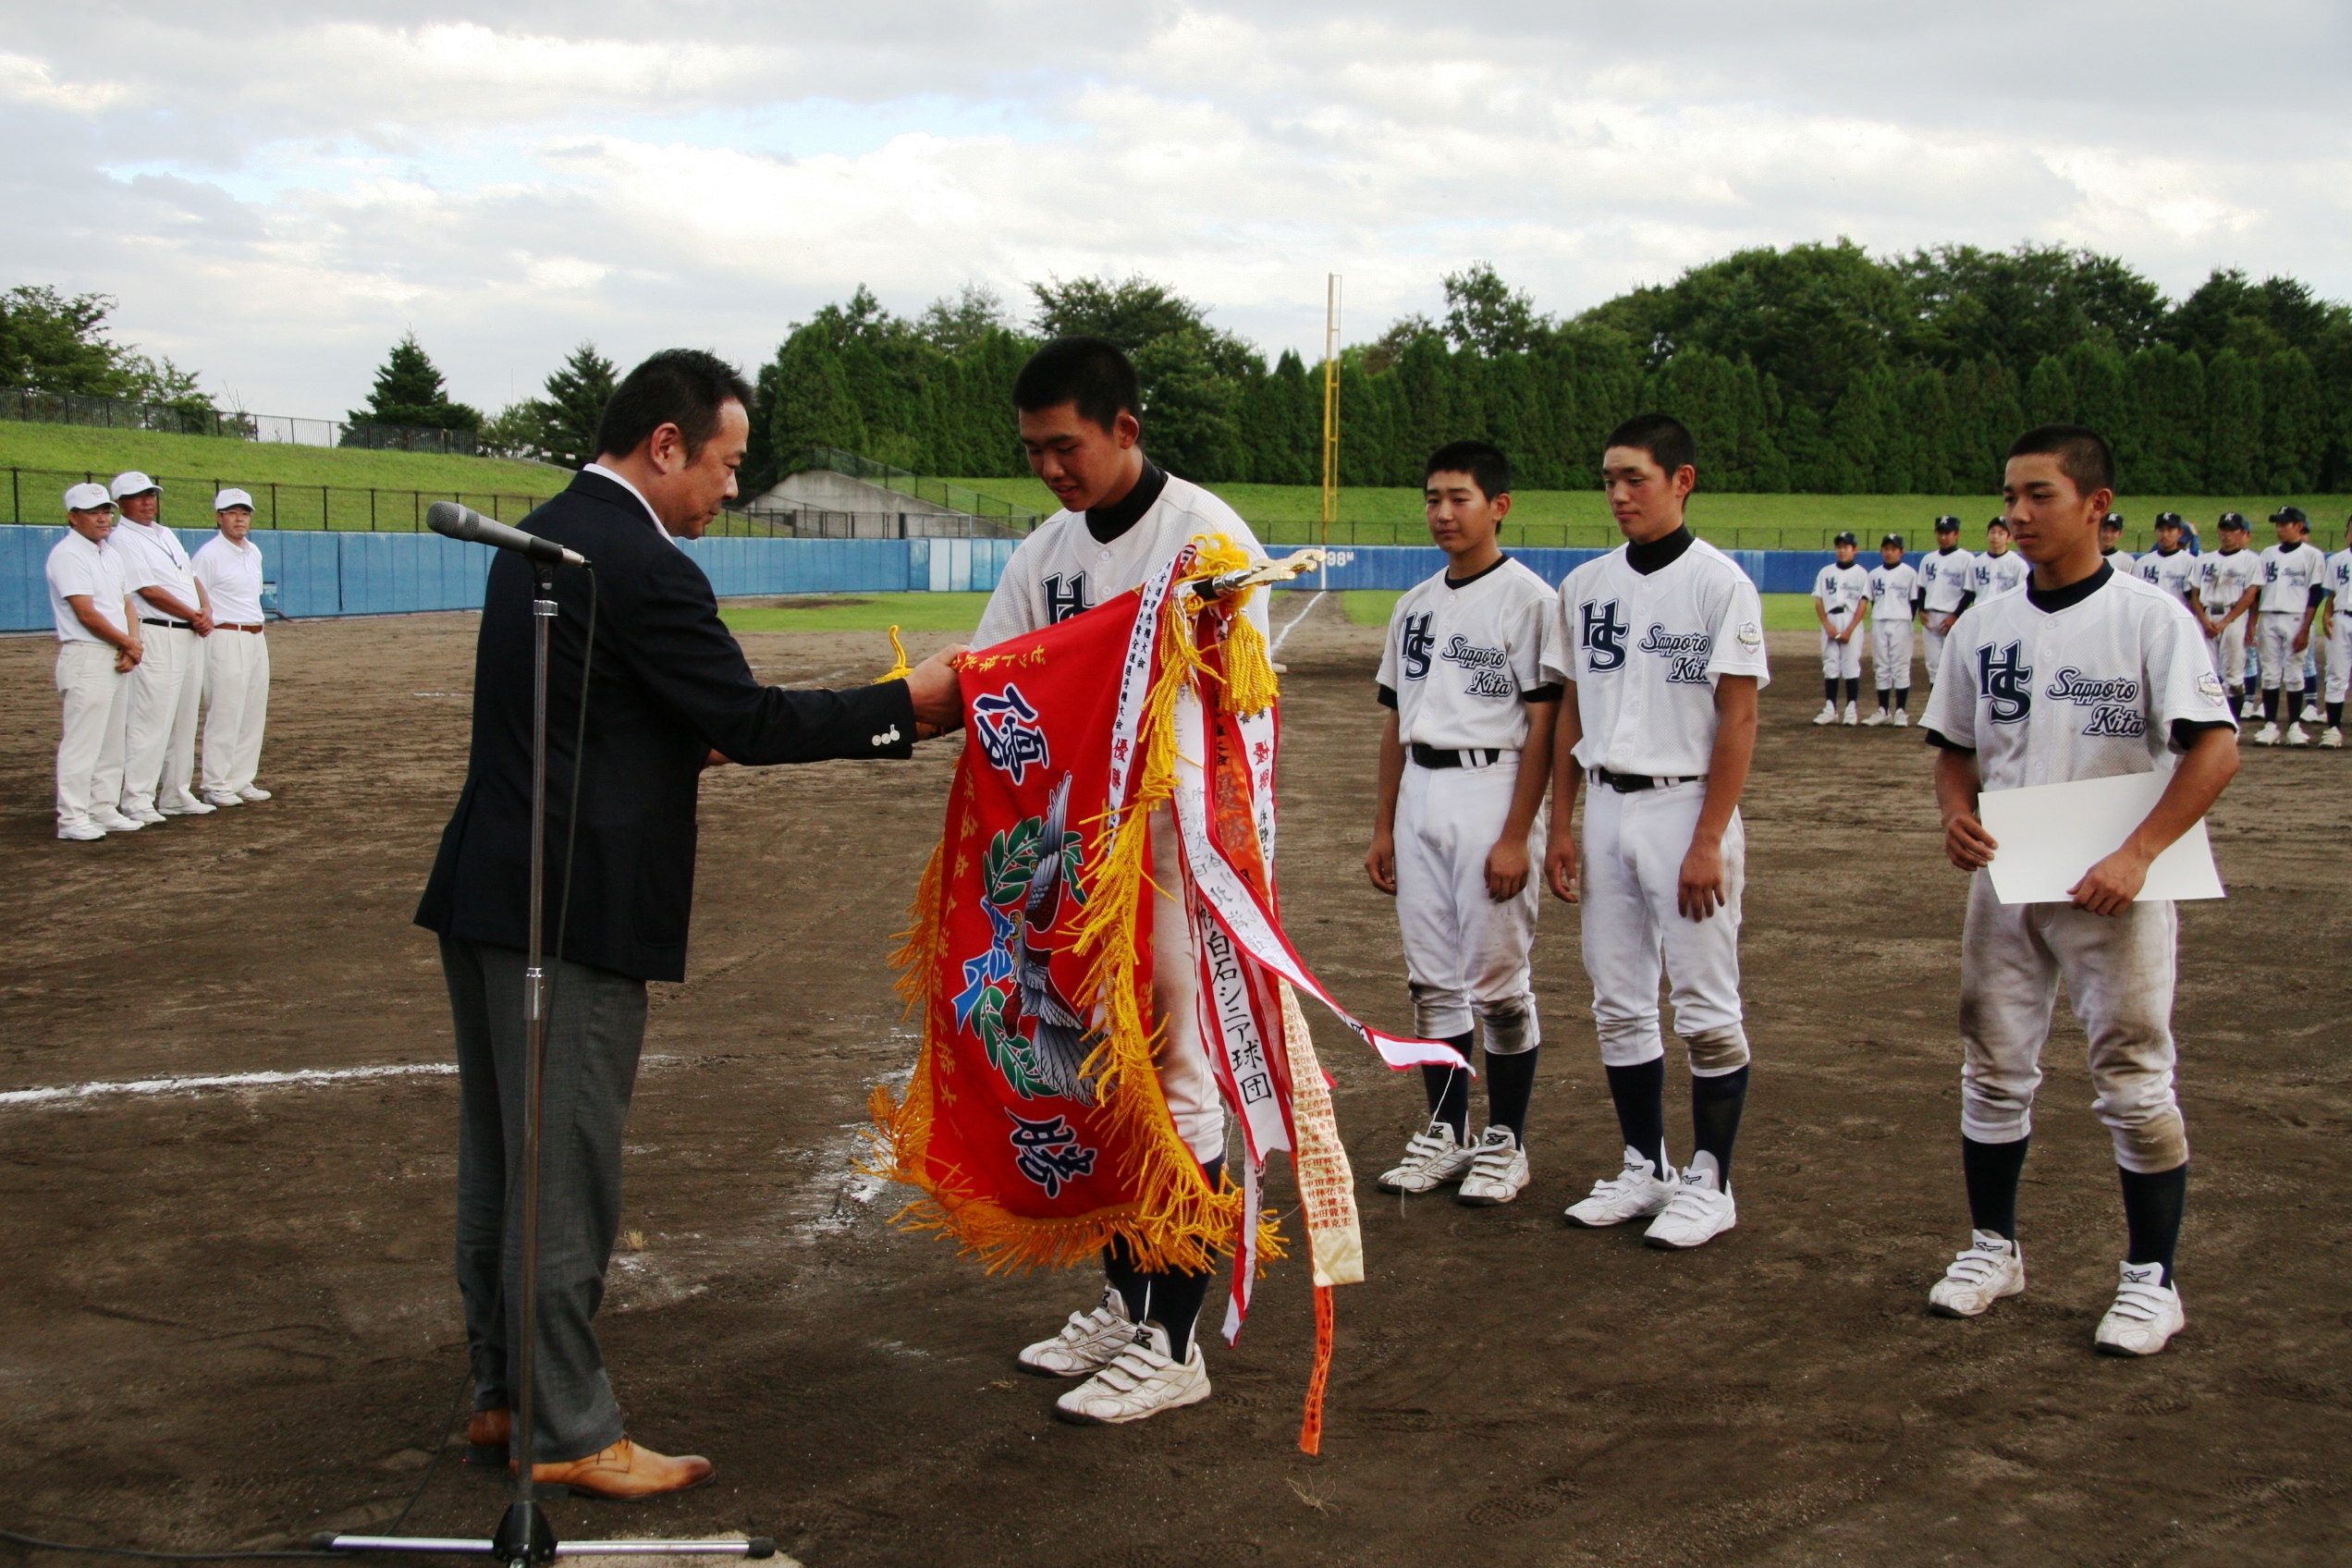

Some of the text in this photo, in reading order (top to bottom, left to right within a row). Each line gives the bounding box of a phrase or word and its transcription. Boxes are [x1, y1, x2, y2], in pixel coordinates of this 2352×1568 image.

[1401, 610, 1436, 681] HS
[1440, 633, 1508, 669] Sapporo
[1579, 597, 1630, 673] HS
[1638, 622, 1709, 658] Sapporo
[1465, 669, 1513, 698] Kita
[1667, 655, 1709, 684] Kit
[1976, 639, 2033, 725] HS
[2046, 666, 2139, 705] Sapporo
[2083, 704, 2147, 738] Kita
